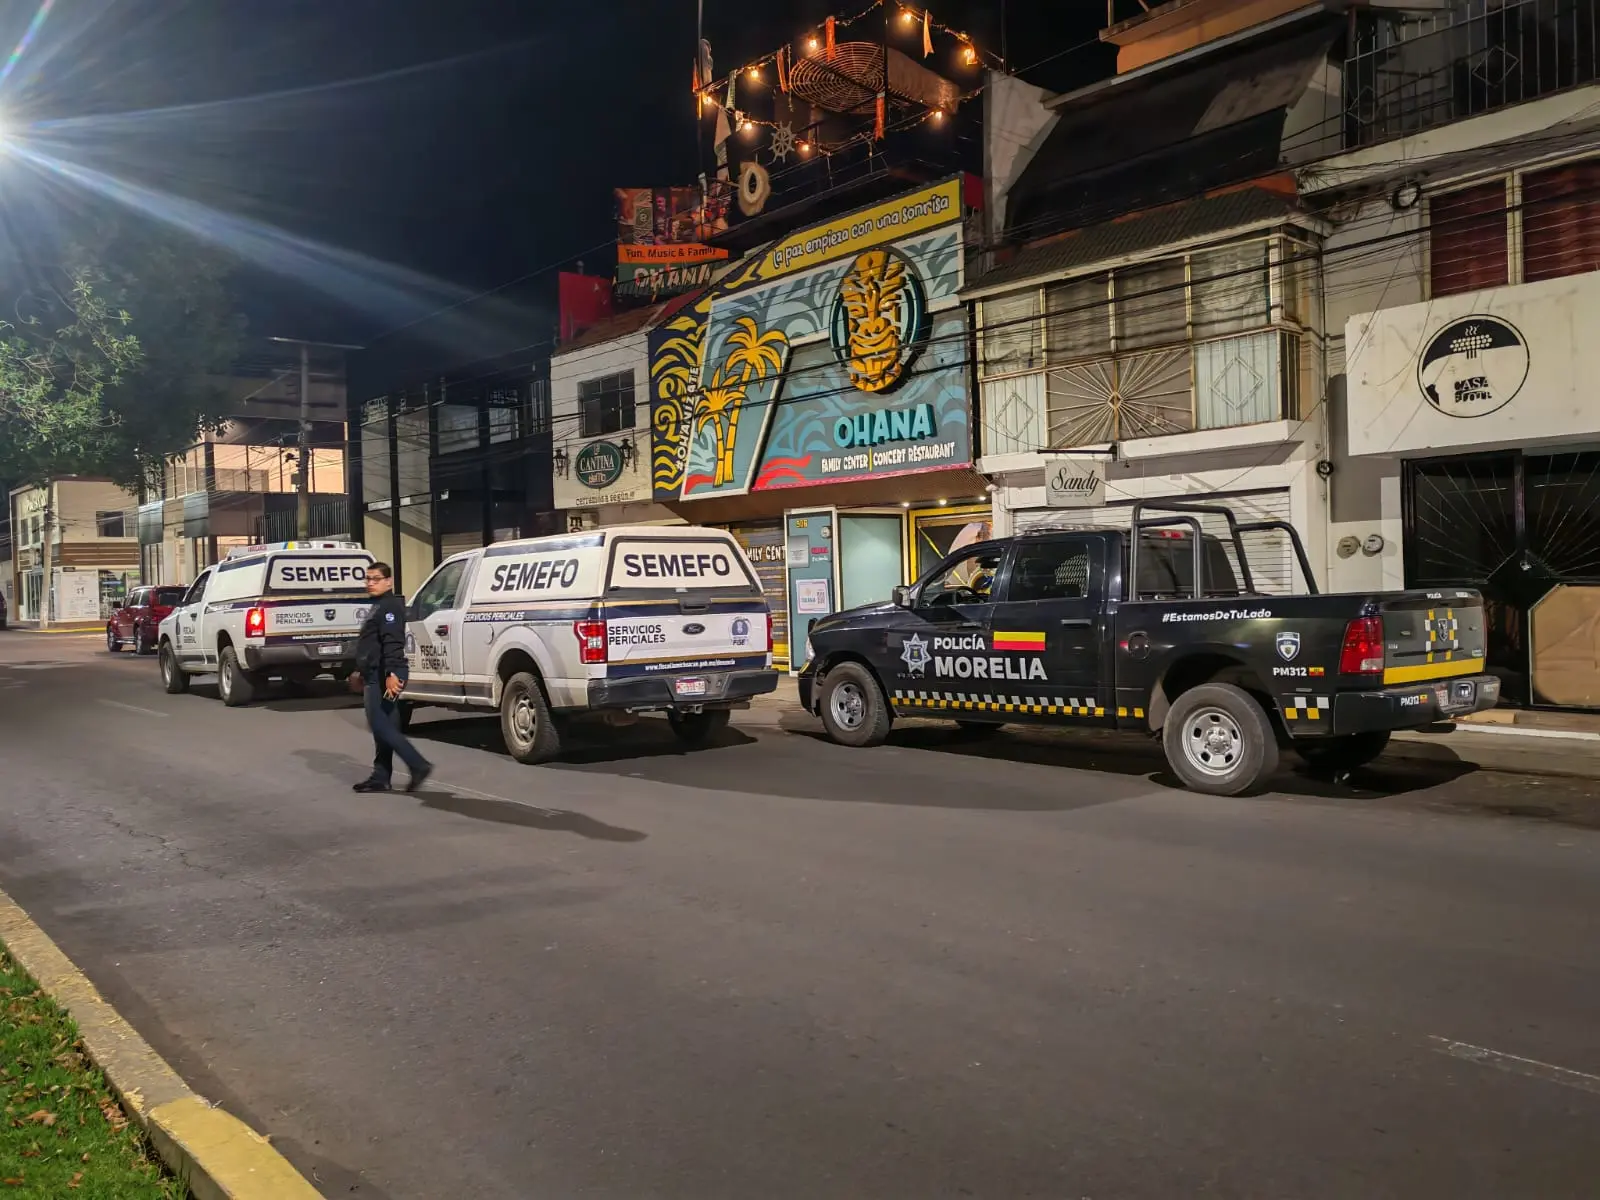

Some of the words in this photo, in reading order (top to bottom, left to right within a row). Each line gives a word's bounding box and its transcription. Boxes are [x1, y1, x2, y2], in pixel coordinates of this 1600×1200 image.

[785, 244, 804, 267] paz
[805, 229, 849, 255] empieza
[851, 219, 874, 239] con
[876, 212, 899, 230] una
[902, 194, 949, 224] sonrisa
[648, 247, 676, 258] Music
[678, 249, 685, 257] &
[833, 403, 936, 449] OHANA
[580, 454, 615, 472] CANTINA
[821, 457, 841, 473] FAMILY
[843, 453, 868, 470] CENTER
[872, 448, 906, 466] CONCERT
[908, 442, 955, 462] RESTAURANT
[1051, 467, 1099, 497] Sandy
[746, 546, 763, 561] MILY
[765, 545, 786, 561] CENT
[623, 553, 731, 577] SEMEFO
[281, 566, 365, 582] SEMEFO
[490, 558, 579, 593] SEMEFO
[1162, 608, 1272, 622] #EstamosDeTuLado
[608, 624, 662, 636] SERVICIOS
[608, 634, 666, 646] PERICIALES
[934, 634, 986, 650] POLICÍA
[420, 642, 447, 657] FISCALÍA
[421, 658, 450, 671] GENERAL
[934, 656, 1048, 680] MORELIA
[1272, 667, 1308, 677] PM312
